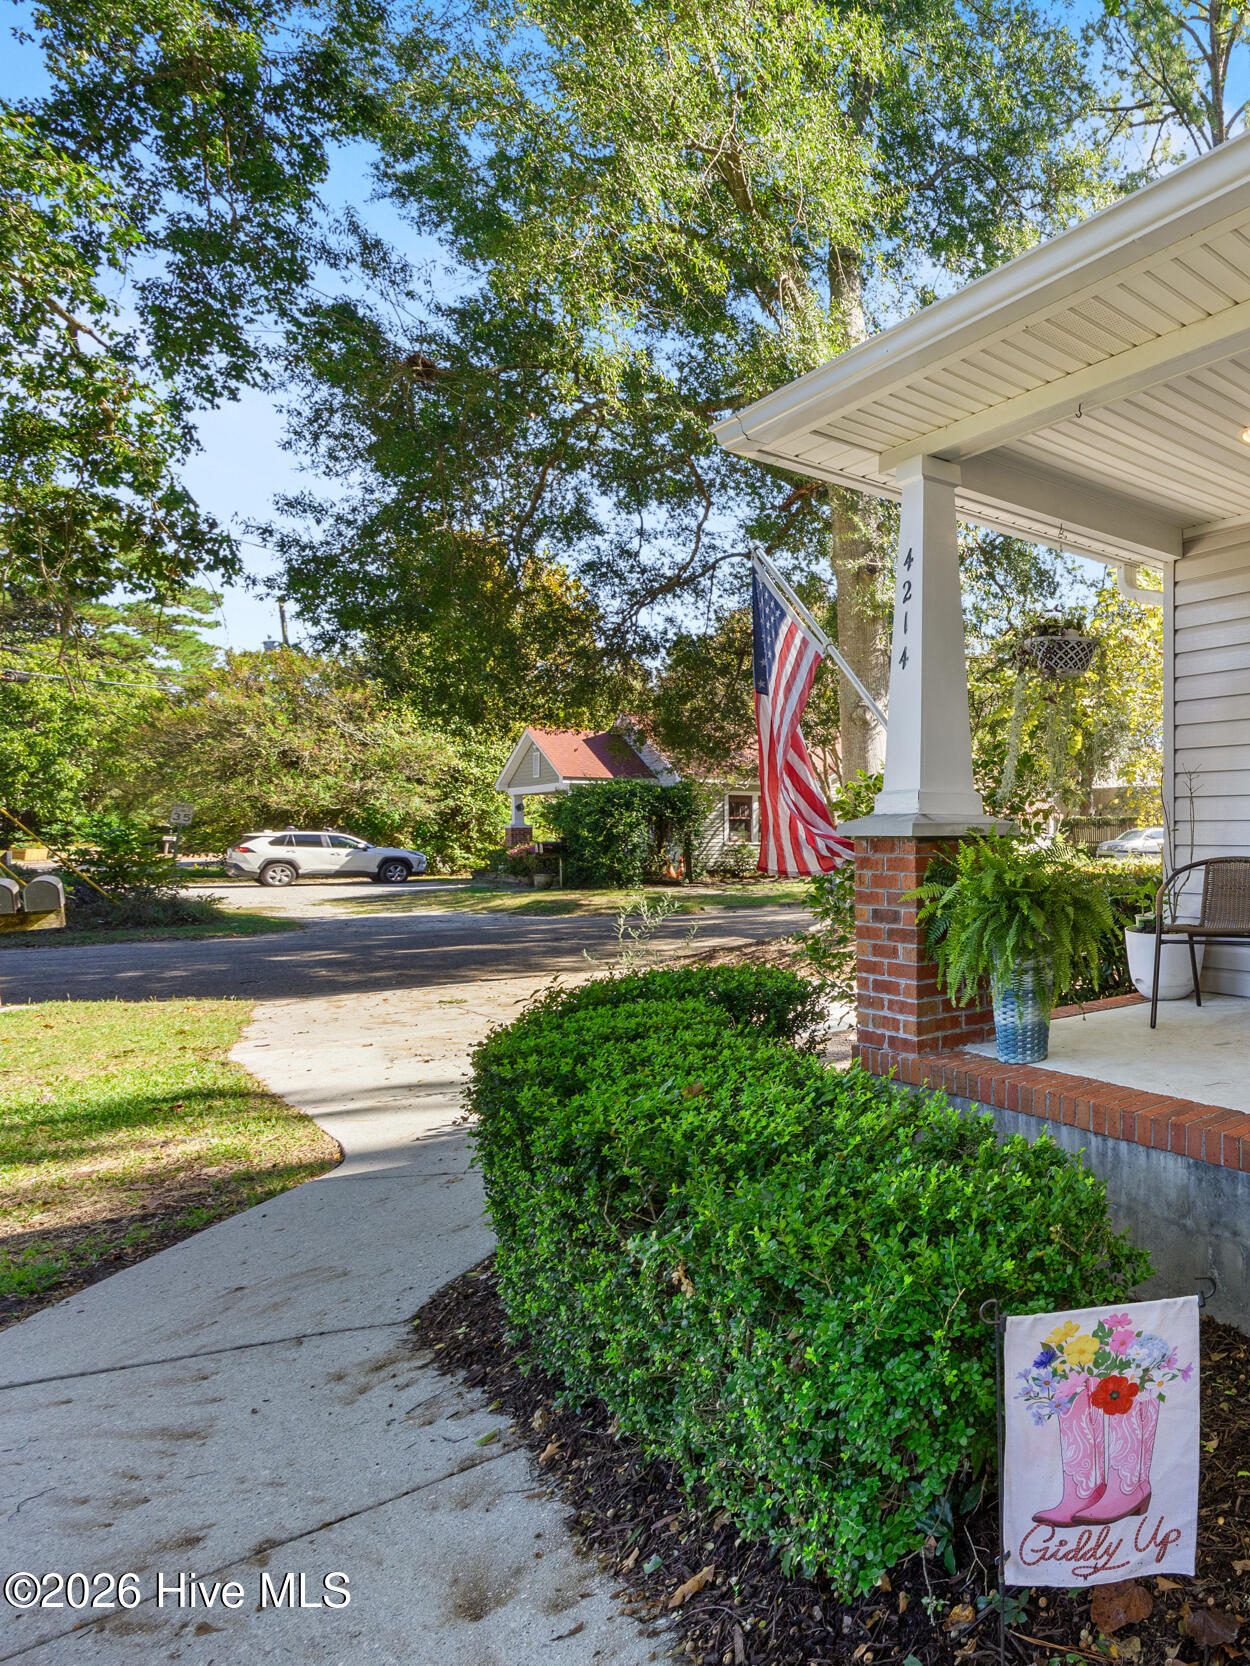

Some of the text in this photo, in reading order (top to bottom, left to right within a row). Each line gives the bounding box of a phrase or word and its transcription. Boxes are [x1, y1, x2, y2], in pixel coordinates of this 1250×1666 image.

[898, 547, 914, 670] 4214
[172, 812, 192, 822] 35
[1018, 1516, 1182, 1577] Giddy Up
